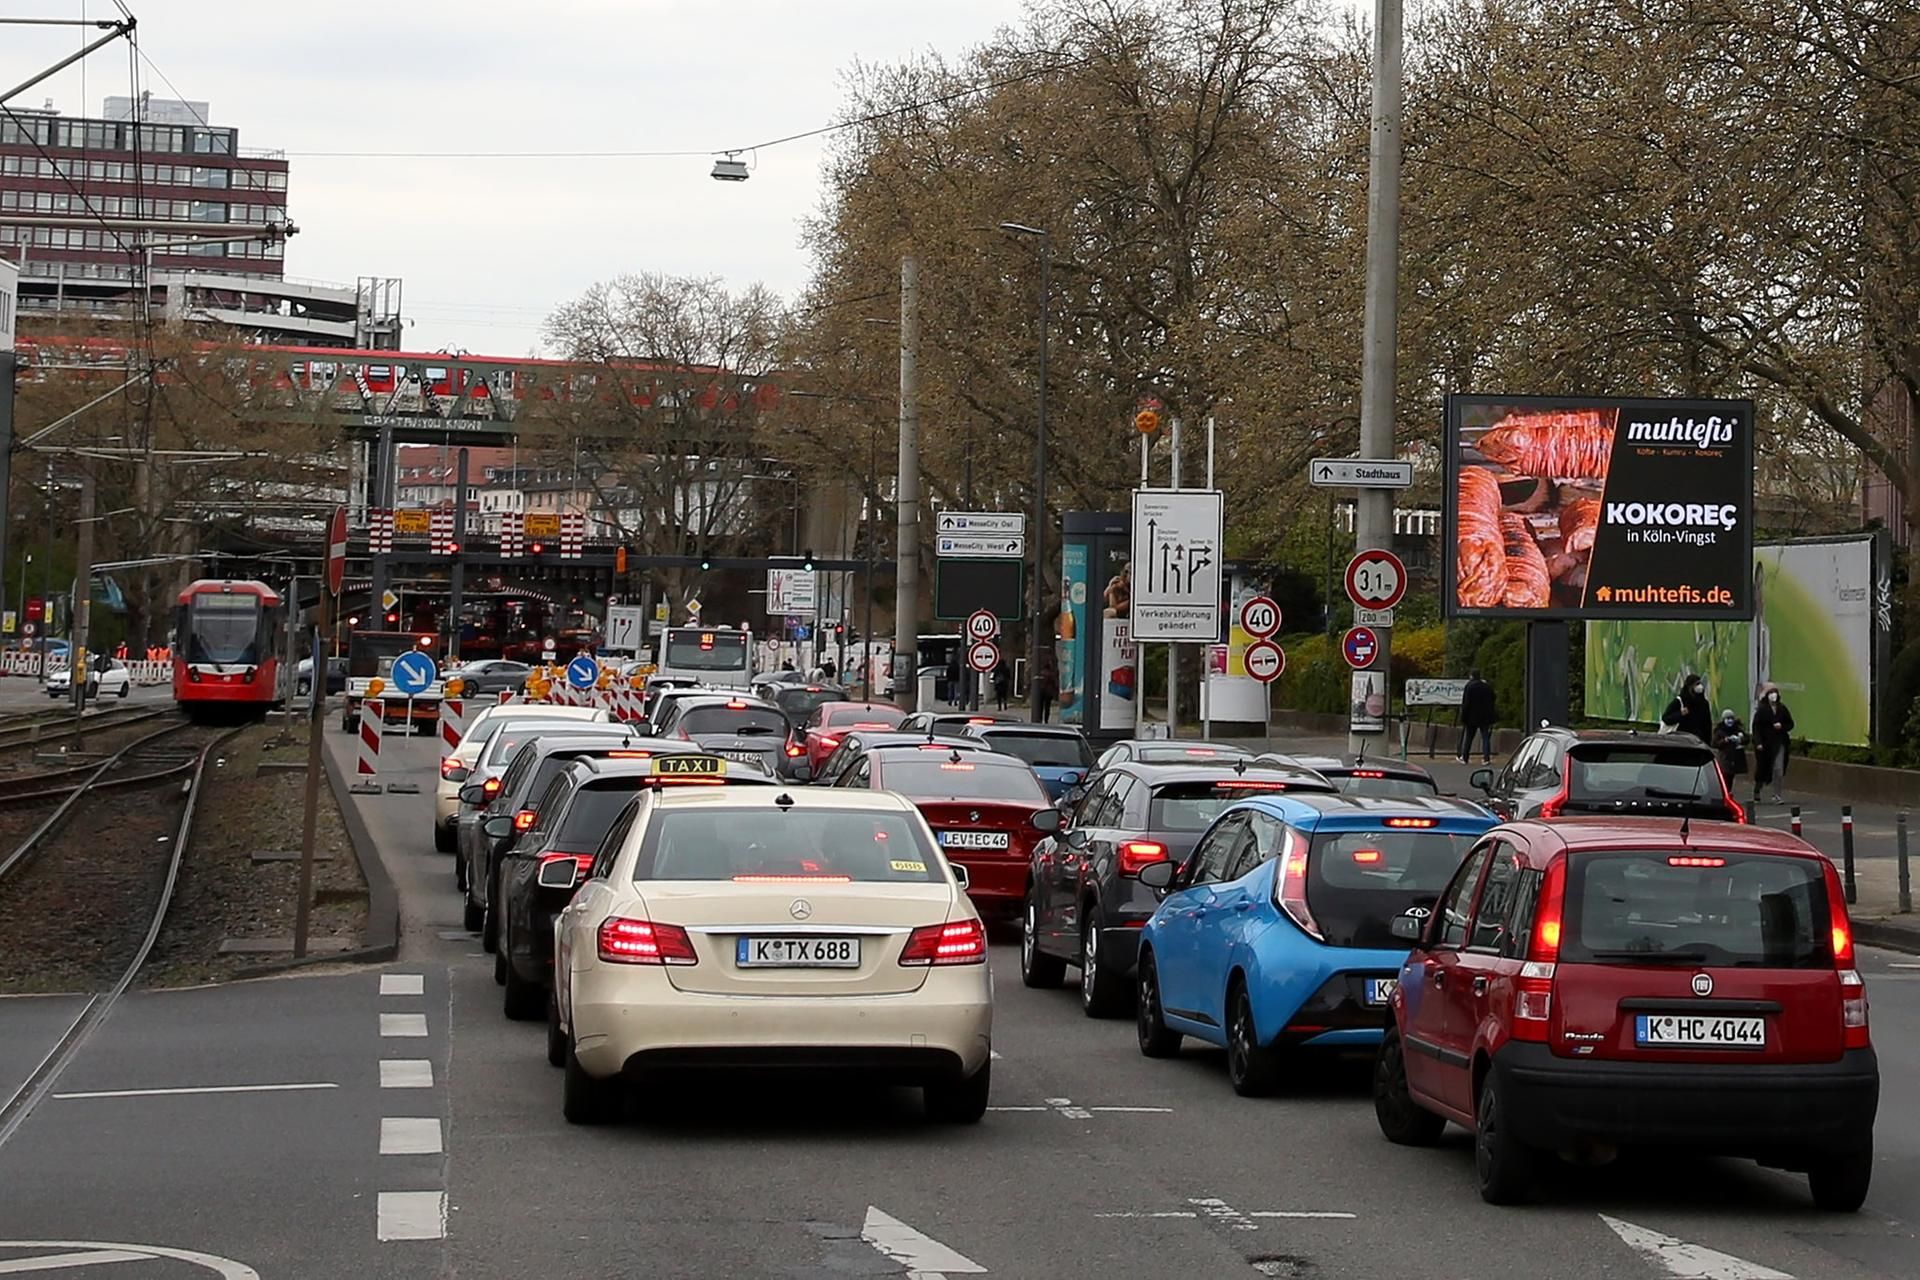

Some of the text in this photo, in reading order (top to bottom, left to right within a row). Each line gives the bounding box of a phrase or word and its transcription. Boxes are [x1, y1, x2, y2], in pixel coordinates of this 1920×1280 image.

[1355, 468, 1401, 479] Stadthaus
[1607, 502, 1737, 531] KOKOREÇ
[1627, 529, 1717, 546] in Köln-Vingst
[1615, 585, 1731, 604] muhtefis.de
[1140, 609, 1211, 621] Verkehrsführung
[1249, 608, 1273, 628] 40
[974, 618, 991, 633] 40
[1158, 621, 1197, 631] geändert
[666, 759, 711, 772] TAXI
[944, 833, 1007, 847] LEV EC 46
[757, 941, 770, 960] K
[784, 941, 810, 960] TX
[814, 941, 851, 960] 688
[1377, 981, 1388, 998] K
[1649, 1018, 1664, 1040] K
[1678, 1018, 1706, 1041] HC
[1710, 1019, 1762, 1042] 4044
